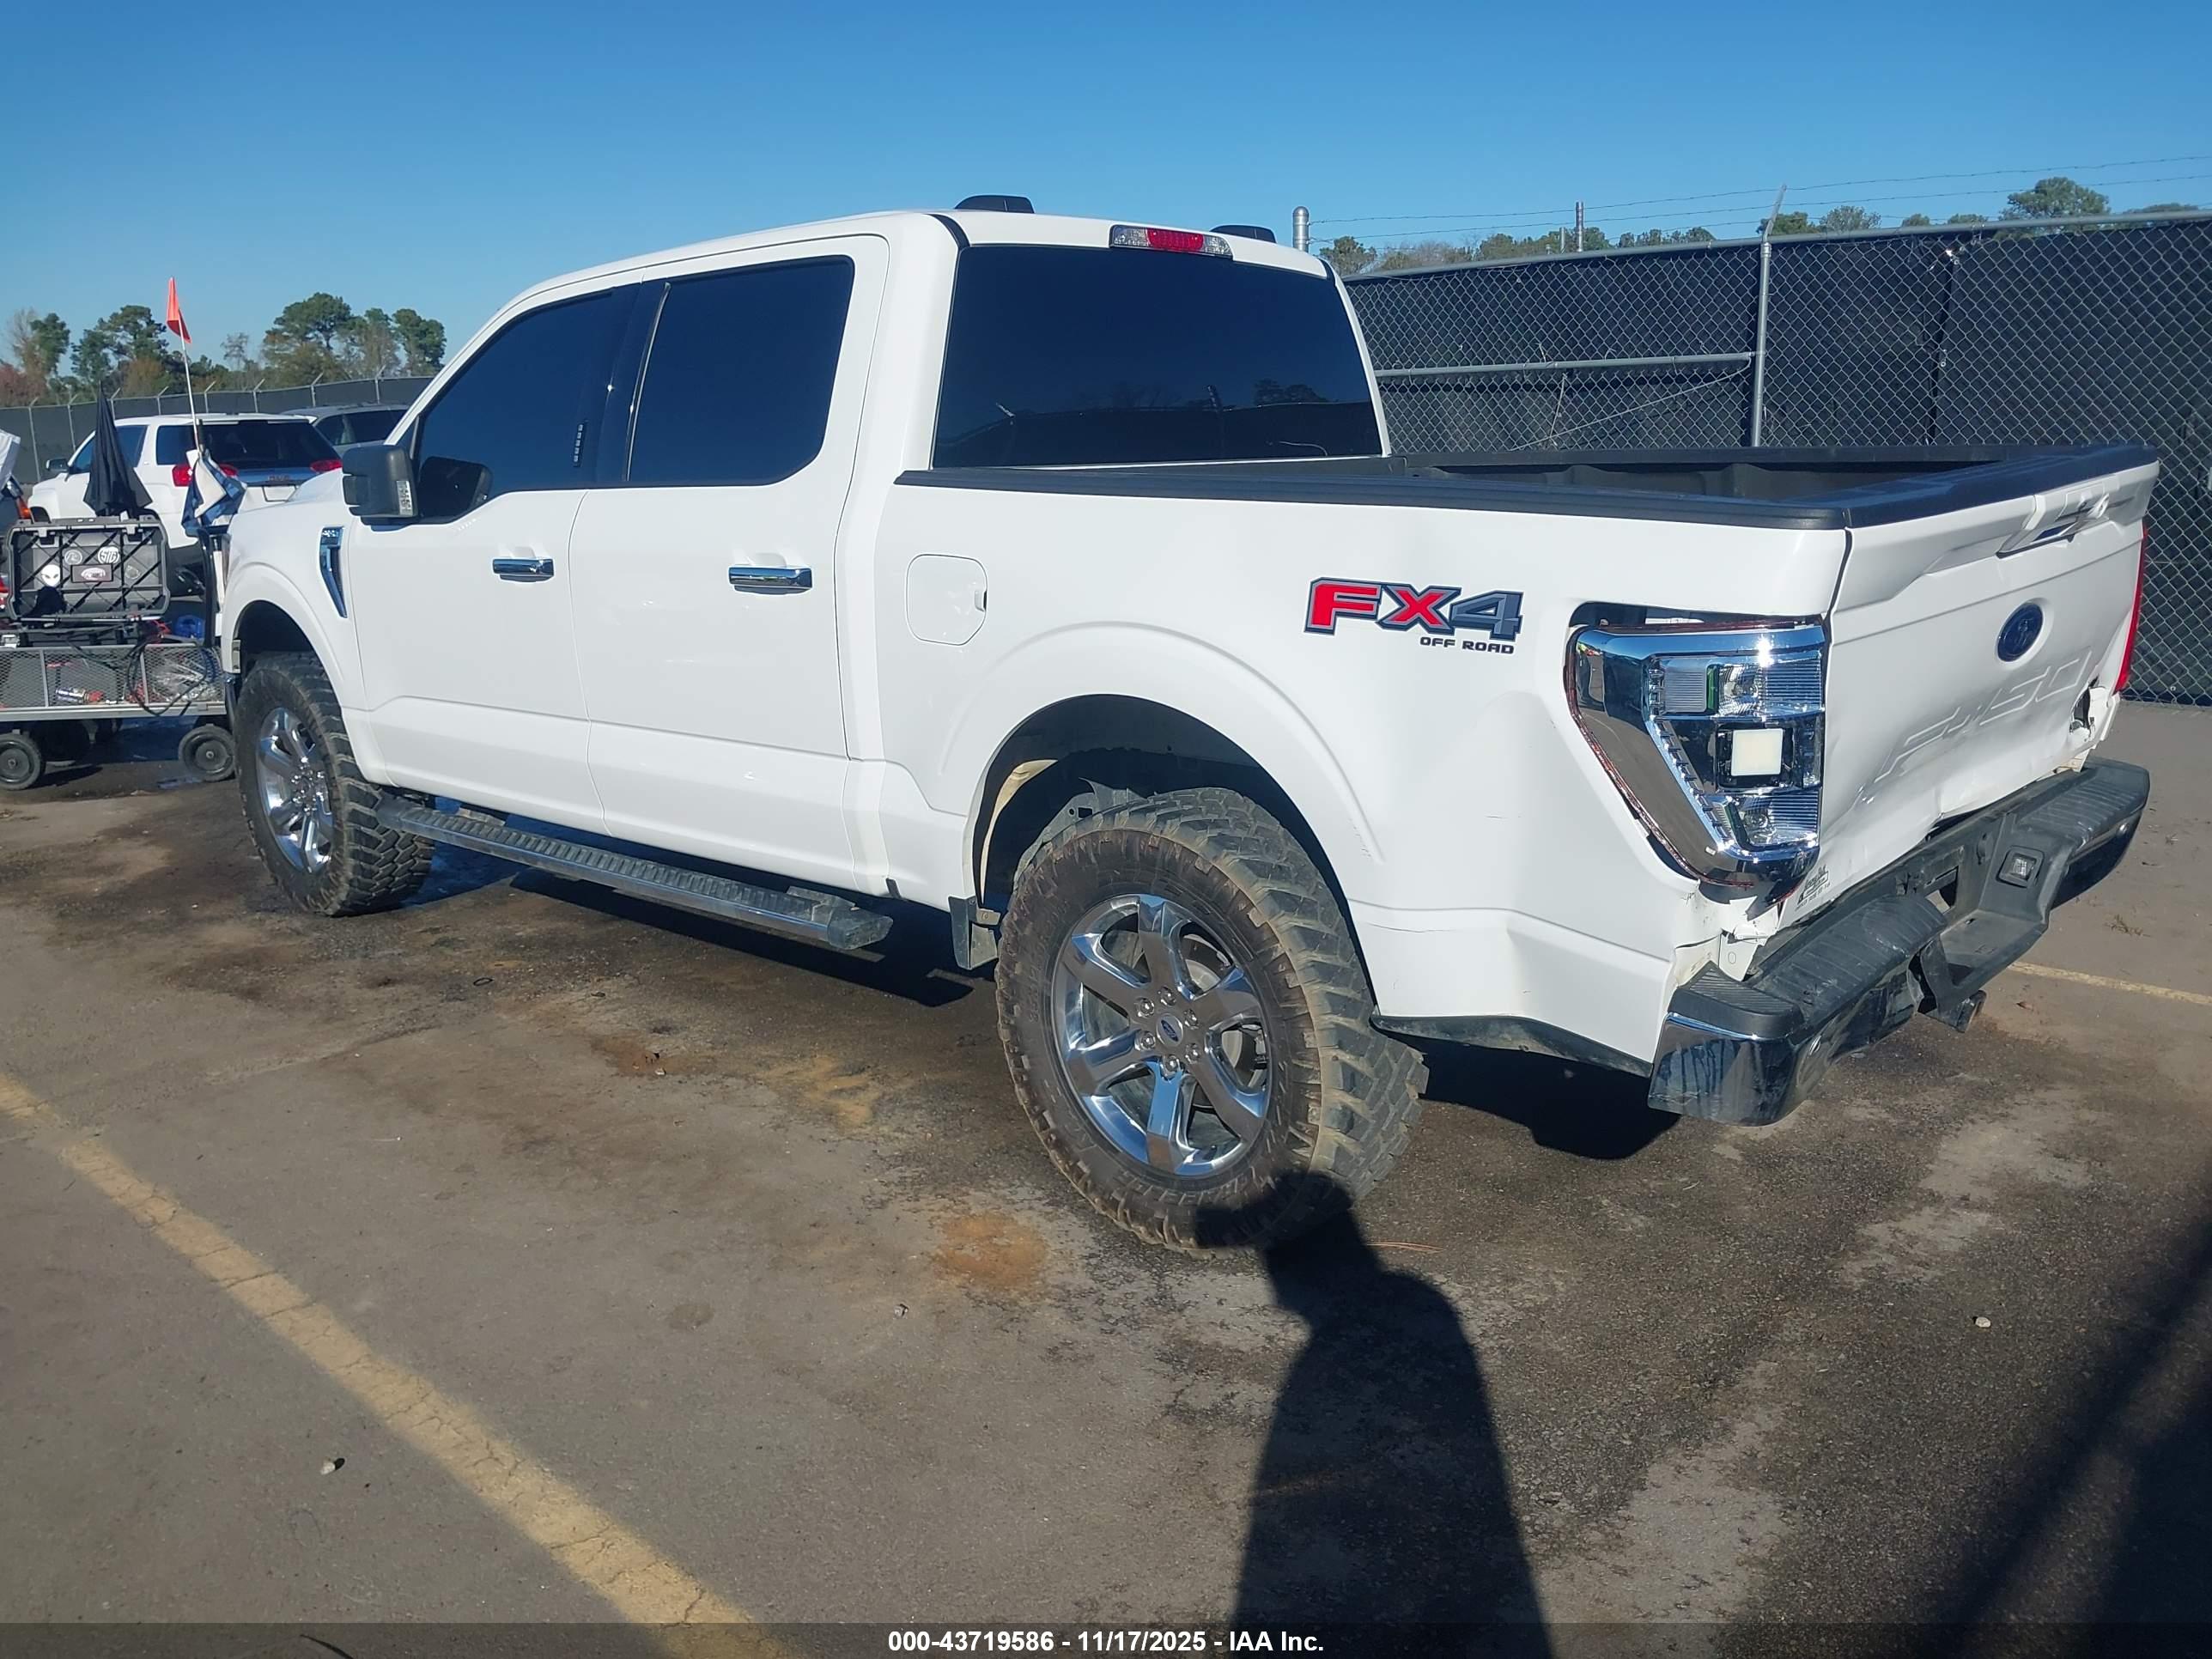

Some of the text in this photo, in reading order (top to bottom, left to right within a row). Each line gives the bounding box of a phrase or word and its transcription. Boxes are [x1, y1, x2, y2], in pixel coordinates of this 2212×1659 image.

[1304, 576, 1524, 641] FX4
[1419, 635, 1515, 655] OFF ROAD
